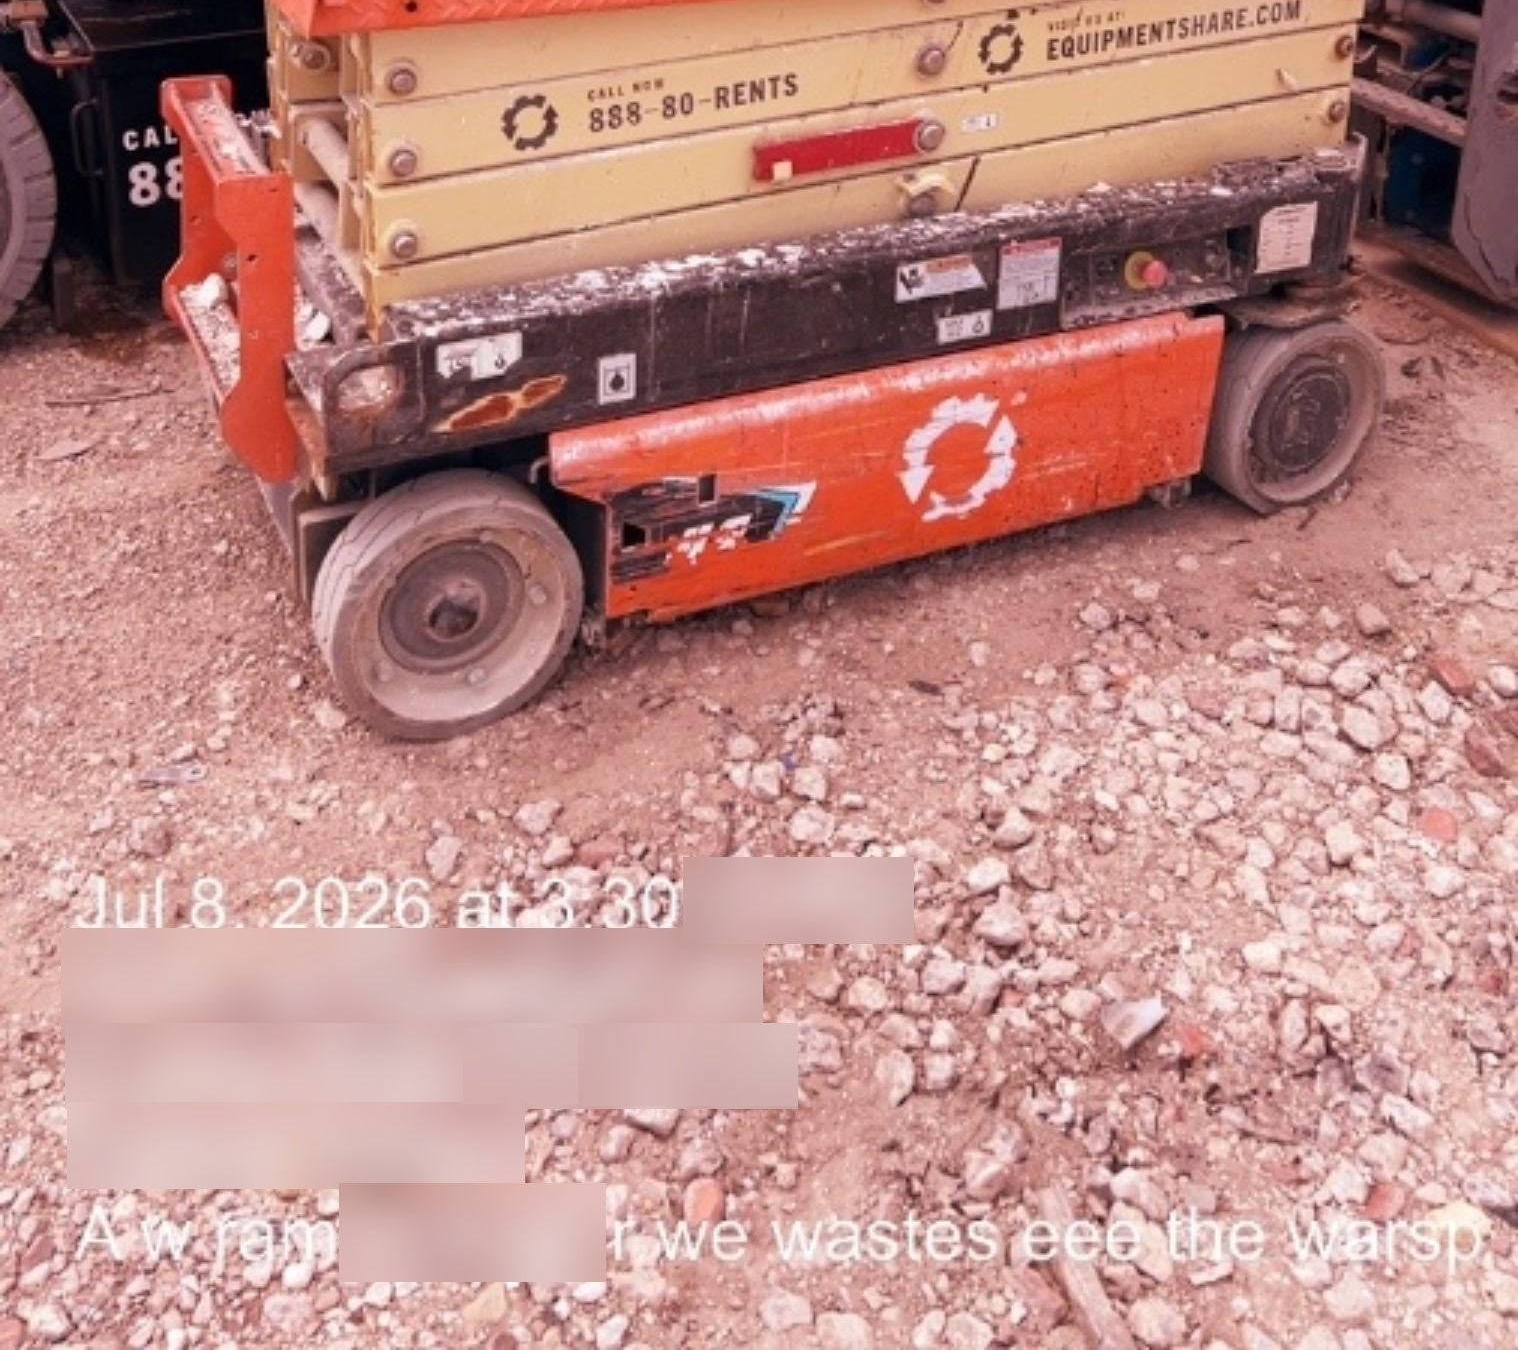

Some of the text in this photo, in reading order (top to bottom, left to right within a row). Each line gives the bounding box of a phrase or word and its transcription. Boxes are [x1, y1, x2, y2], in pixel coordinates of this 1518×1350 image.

[1046, 0, 1302, 62] EQUIPMENTSHARE.COM
[586, 84, 625, 103] CALL
[589, 72, 799, 133] 888-80-RENTS
[122, 125, 179, 151] CAL
